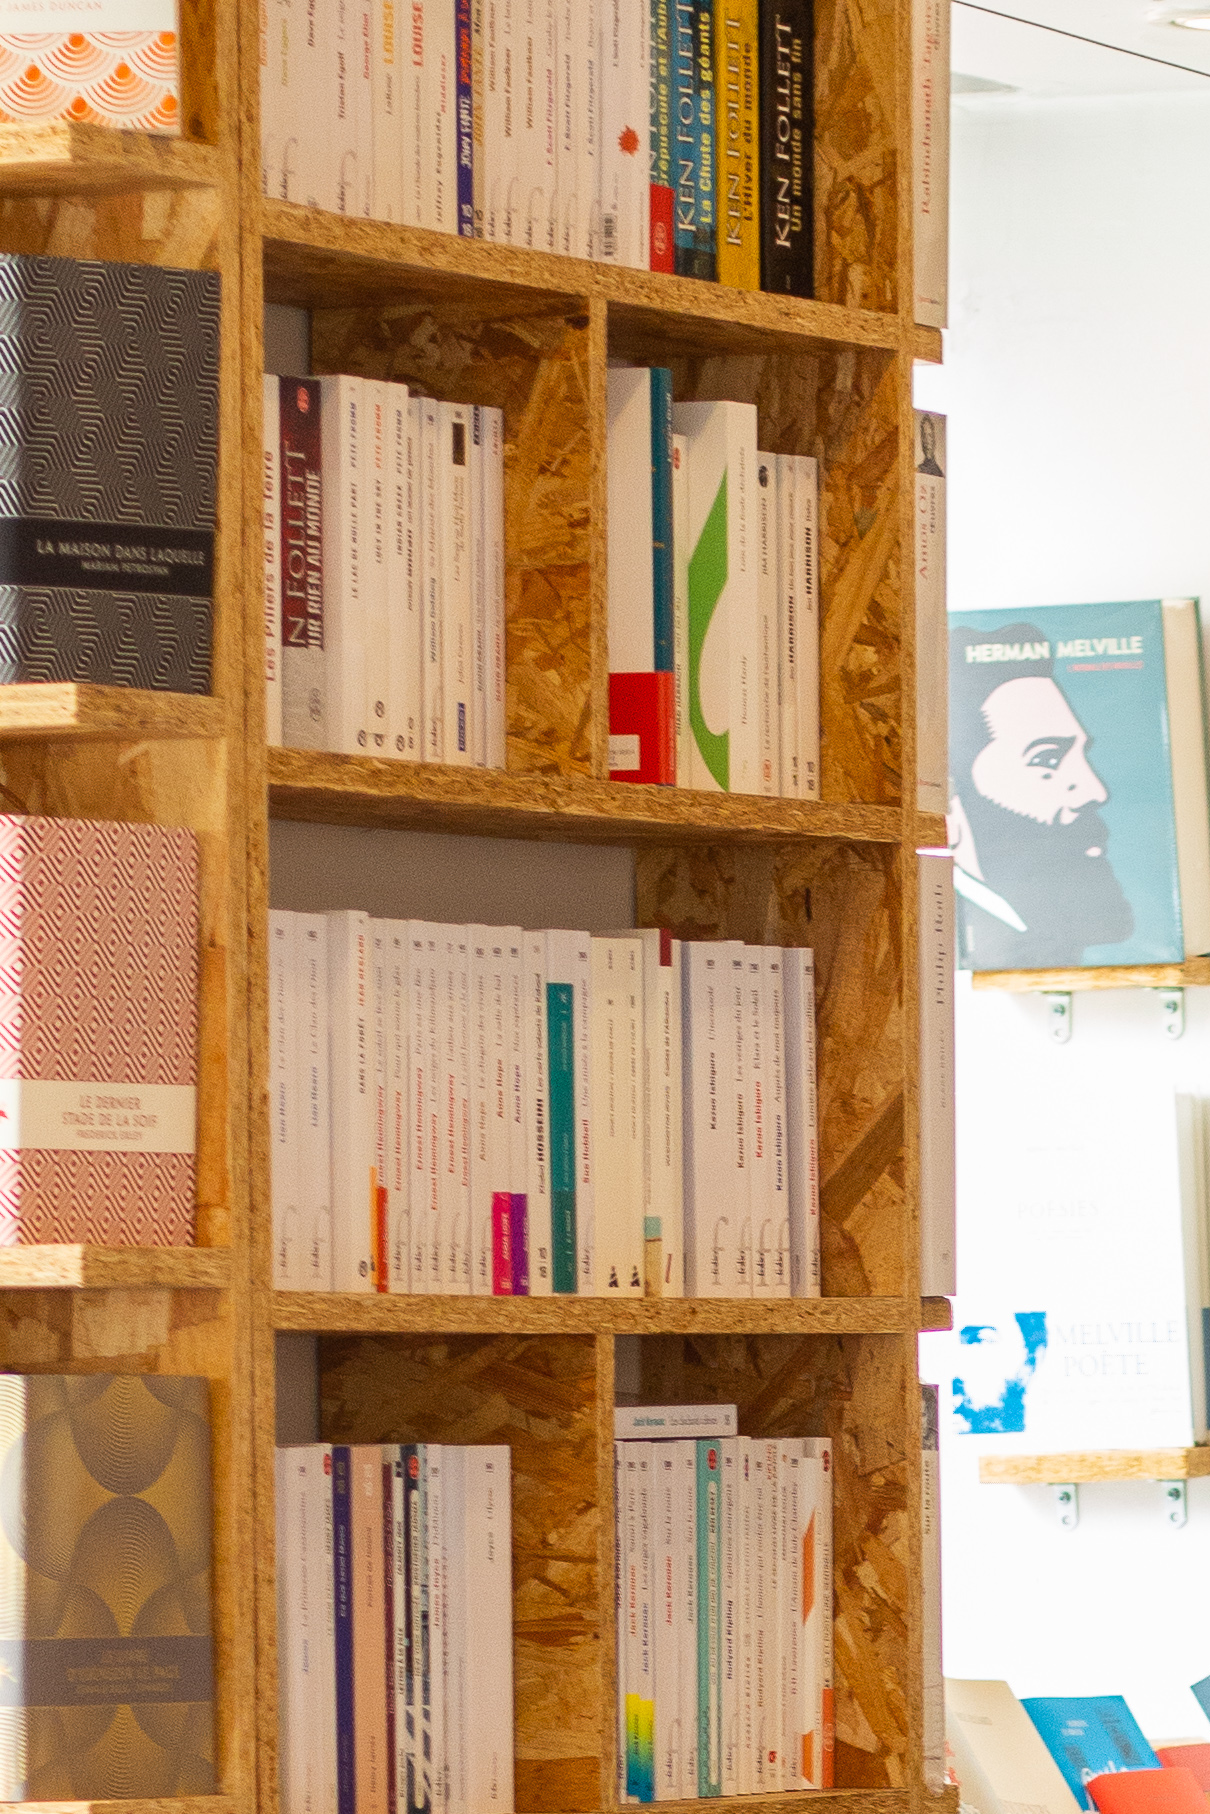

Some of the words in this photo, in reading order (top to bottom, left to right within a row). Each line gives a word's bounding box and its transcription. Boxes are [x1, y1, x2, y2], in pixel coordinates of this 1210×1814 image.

[382, 2, 394, 65] LOUISE
[412, 2, 424, 68] LOUISE
[698, 12, 715, 82] géants
[790, 38, 802, 65] fin
[674, 0, 695, 144] FOLLETT
[725, 17, 741, 157] FOLLETT
[742, 42, 753, 112] monde
[774, 13, 792, 161] FOLLETT
[791, 72, 801, 120] sans
[699, 89, 712, 126] des
[742, 119, 753, 144] du
[699, 132, 712, 192] Chute
[742, 152, 754, 221] L'Hiver
[791, 128, 802, 196] monde
[677, 160, 696, 233] KEN
[700, 200, 712, 225] La
[725, 174, 740, 246] KEN
[776, 177, 792, 249] KEN
[791, 204, 802, 232] Un
[262, 451, 275, 502] Terre
[305, 468, 322, 537] MONDE
[263, 513, 275, 531] la
[284, 440, 306, 599] FOLLETT
[36, 539, 55, 554] LA
[58, 542, 111, 559] MAISON
[114, 544, 147, 560] DANS
[150, 547, 205, 566] LAQUELLE
[264, 539, 276, 564] de
[307, 539, 322, 568] AU
[263, 572, 276, 638] Piliers
[307, 570, 322, 614] RIEN
[264, 648, 277, 682] Les
[965, 641, 1050, 664] HERMAN
[1055, 635, 1144, 658] MELVILLE
[1055, 1320, 1182, 1345] MELVILLE
